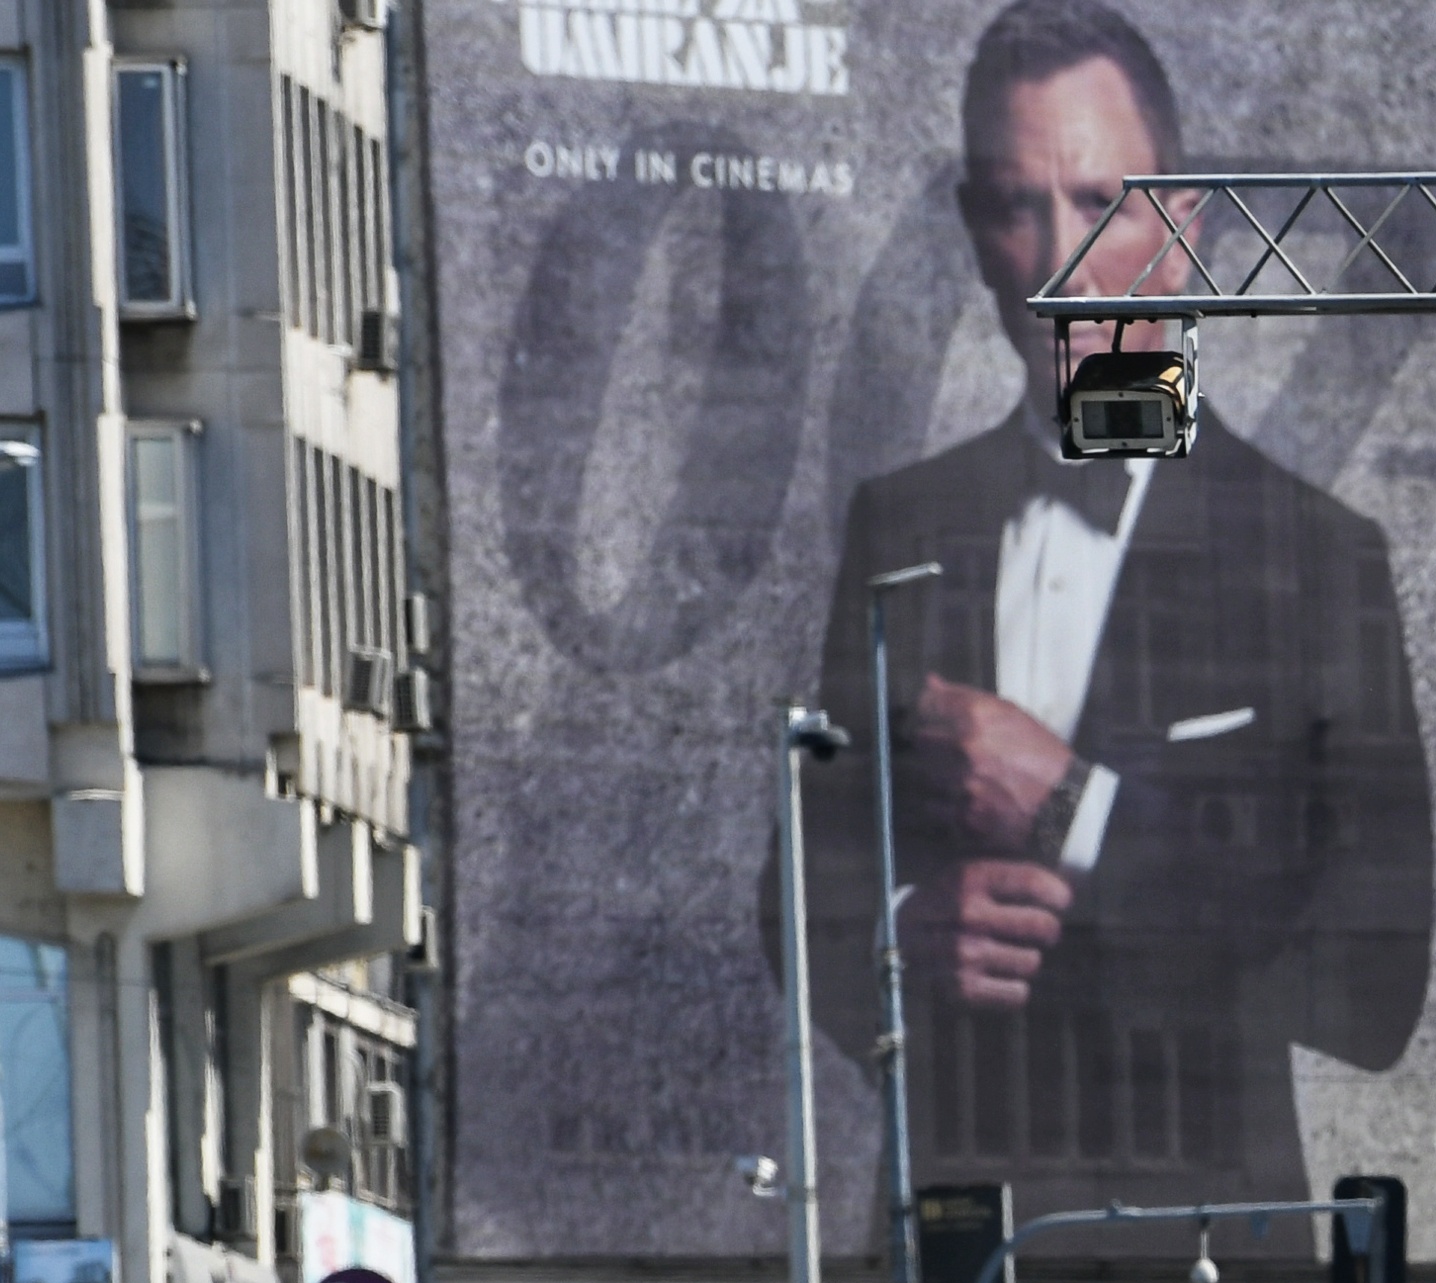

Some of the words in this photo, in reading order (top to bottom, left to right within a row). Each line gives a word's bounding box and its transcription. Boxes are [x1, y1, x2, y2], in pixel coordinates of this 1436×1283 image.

[519, 7, 851, 95] UMIRANJE
[525, 140, 620, 182] ONLY
[634, 149, 678, 185] IN
[690, 152, 855, 196] CINEMAS
